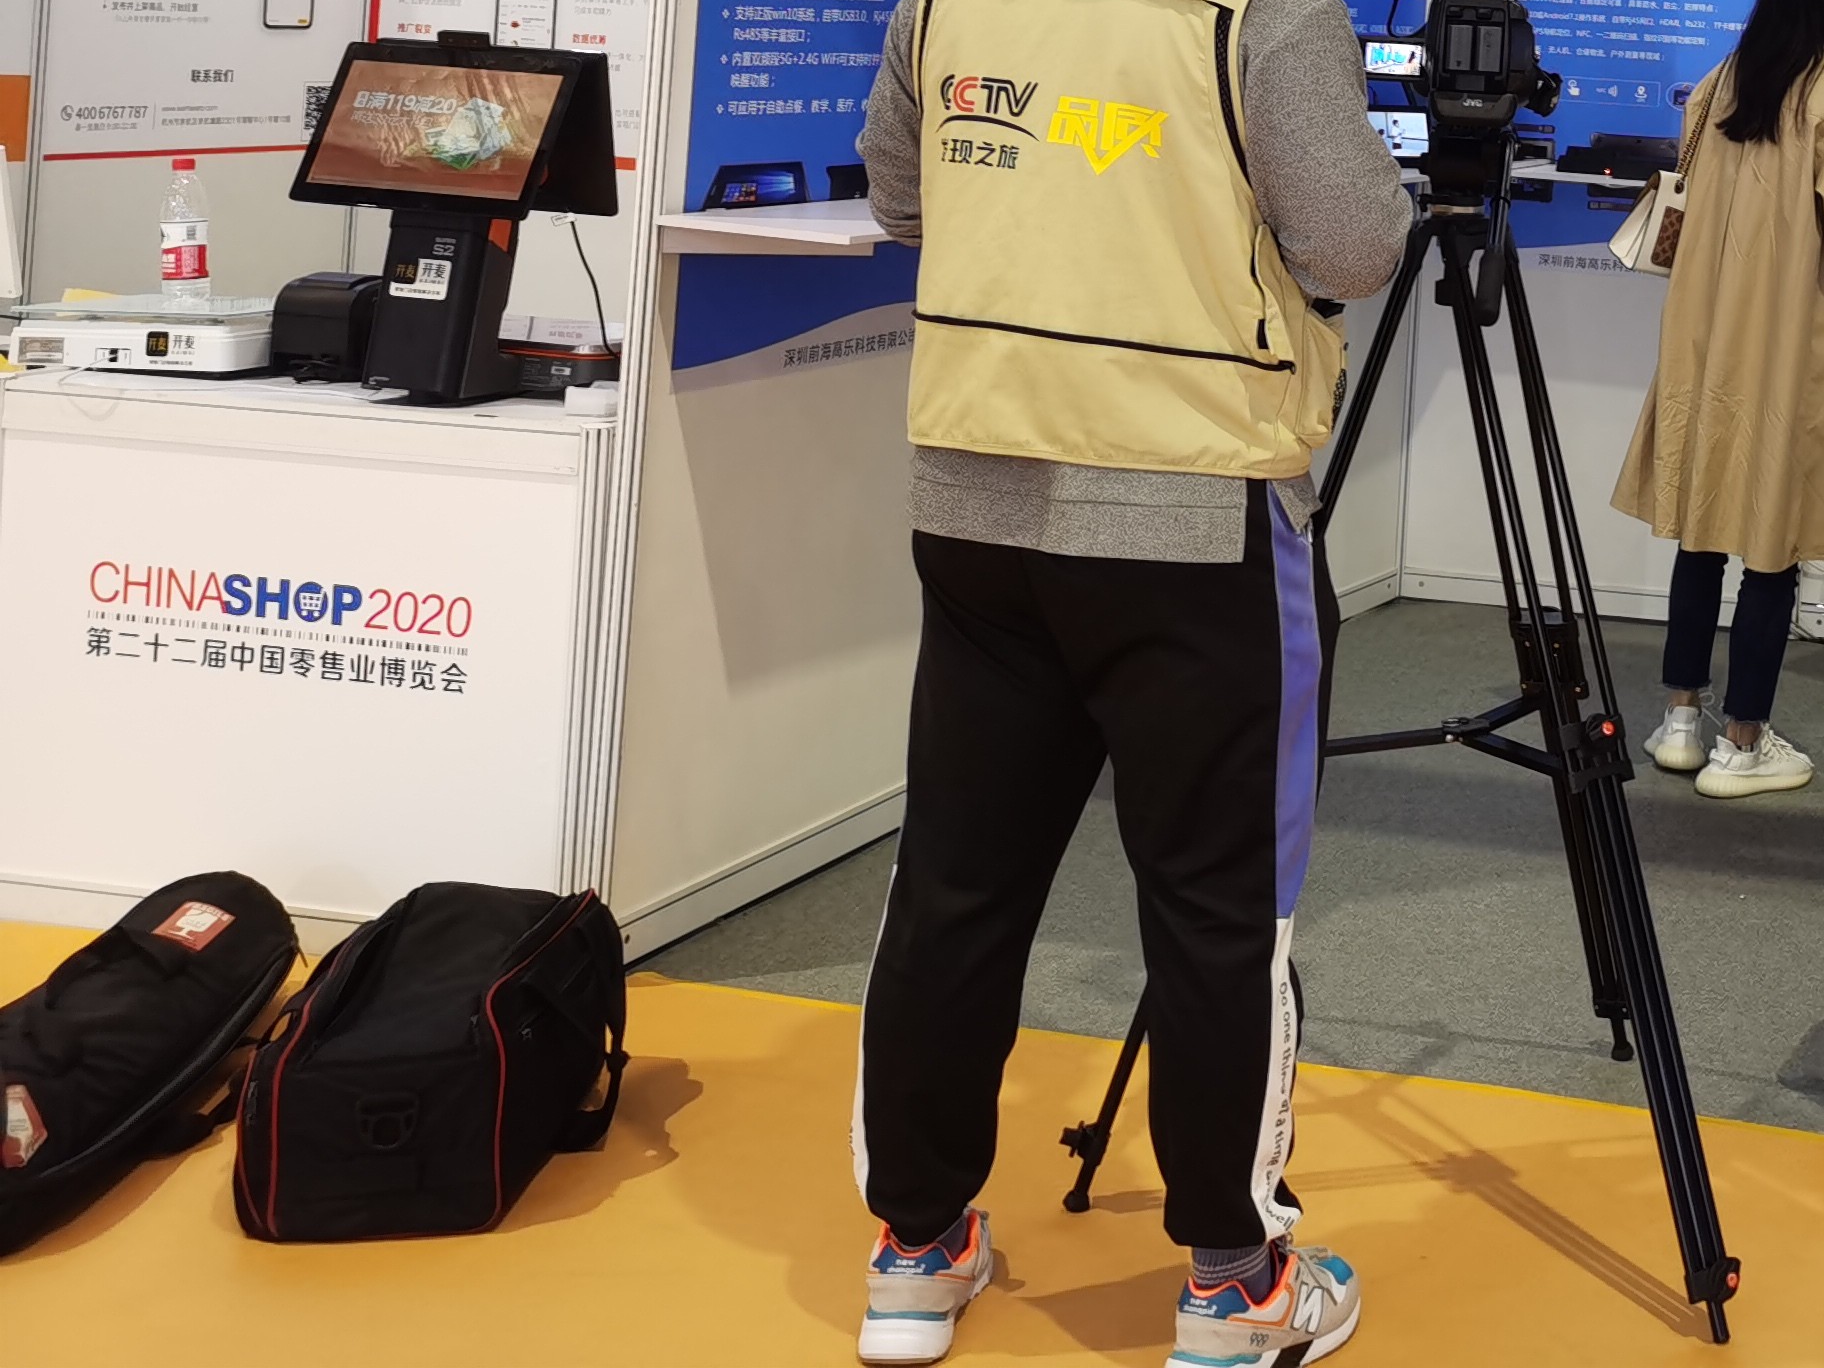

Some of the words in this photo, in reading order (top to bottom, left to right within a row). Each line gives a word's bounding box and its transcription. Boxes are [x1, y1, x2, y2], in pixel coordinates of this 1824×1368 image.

[190, 69, 234, 83] 联系我们
[942, 138, 1020, 170] 现之旅
[421, 262, 447, 279] 开麦
[1538, 253, 1643, 274] 深圳前海高乐科
[84, 626, 468, 694] 第二十二届中国零售业博览会
